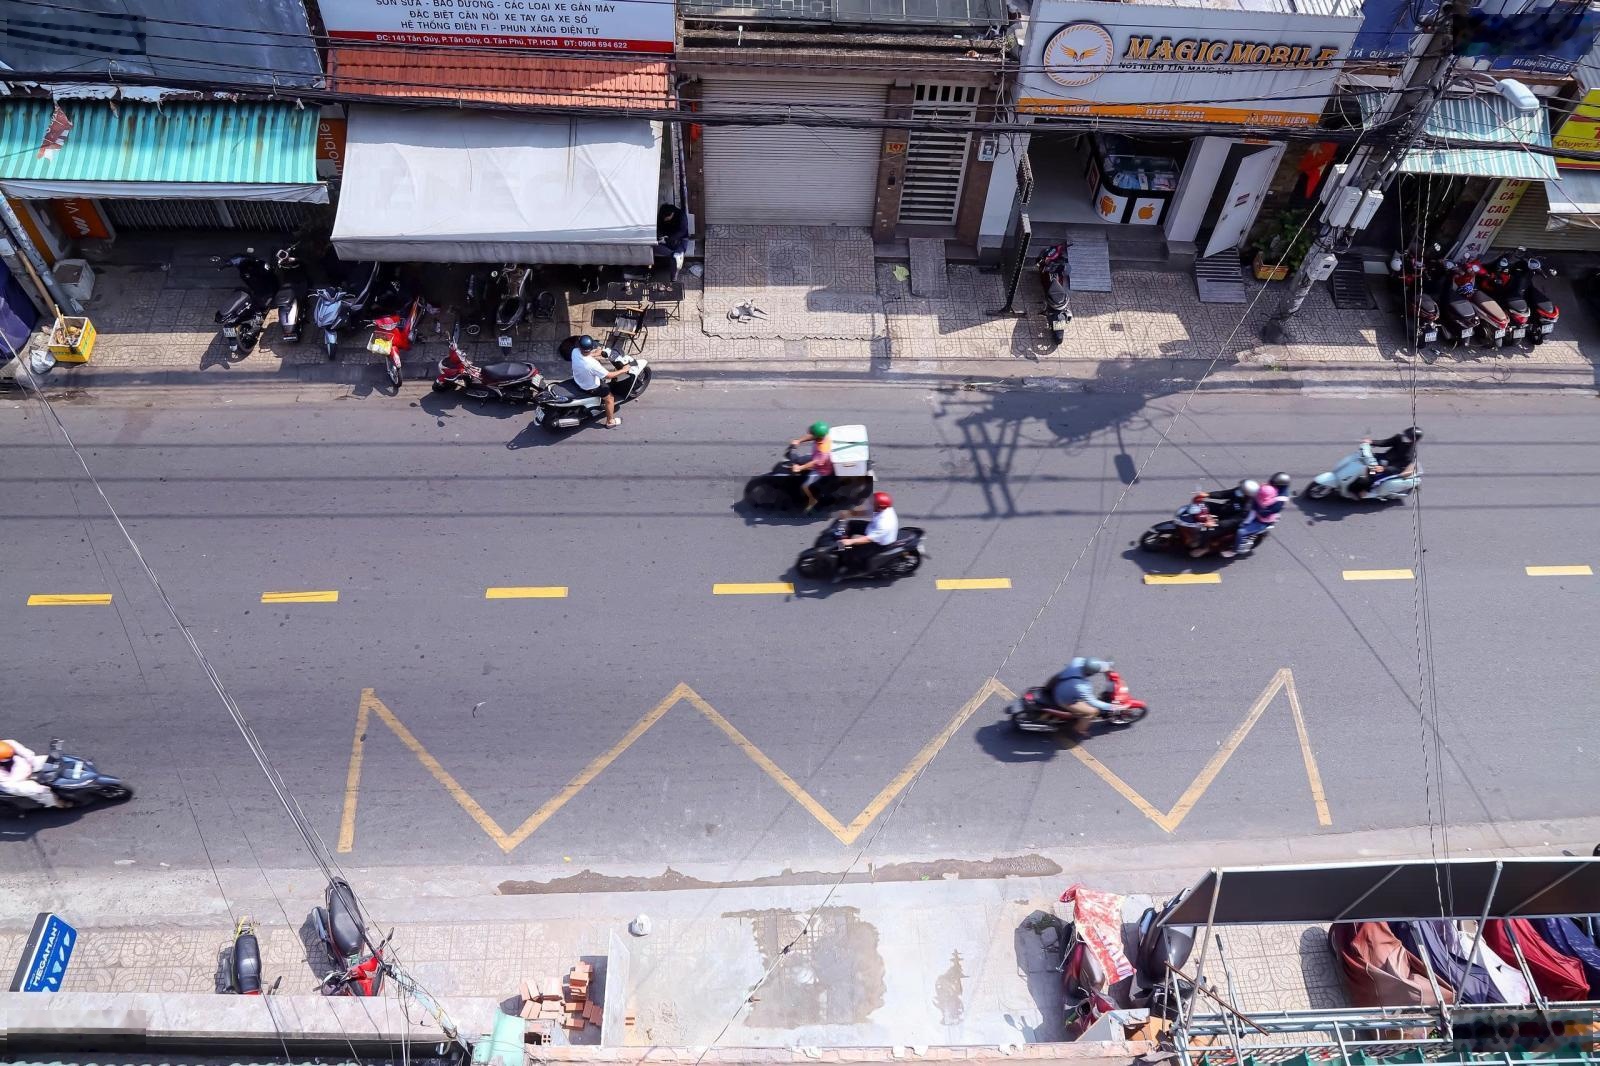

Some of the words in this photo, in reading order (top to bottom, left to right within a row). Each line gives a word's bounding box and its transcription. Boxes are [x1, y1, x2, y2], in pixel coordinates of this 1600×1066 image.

[554, 3, 567, 11] XE
[504, 13, 517, 21] XE
[521, 14, 536, 22] TAY
[558, 15, 570, 23] XE
[481, 23, 489, 31] FI
[500, 24, 526, 33] PHUN
[1124, 36, 1228, 64] MAGIC
[1227, 42, 1339, 69] MOBILE
[33, 927, 58, 987] MEGAMAN
